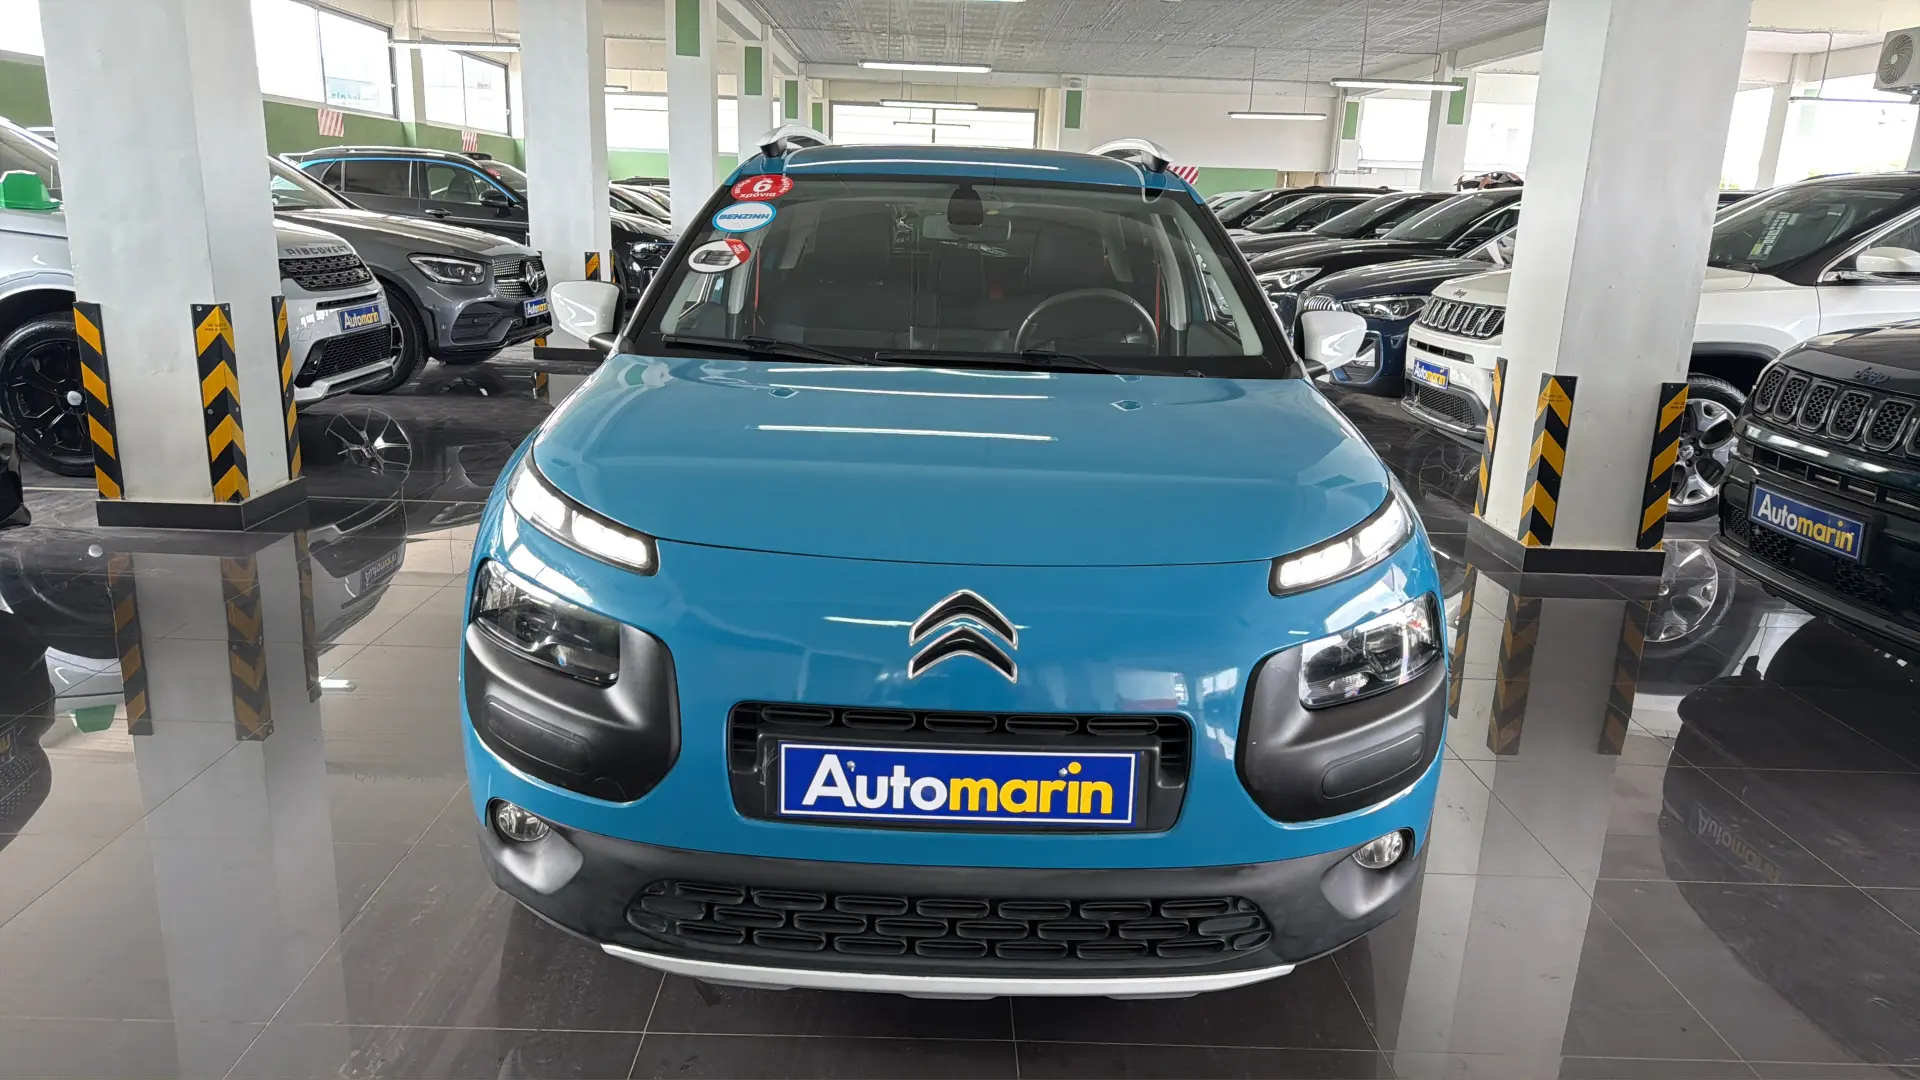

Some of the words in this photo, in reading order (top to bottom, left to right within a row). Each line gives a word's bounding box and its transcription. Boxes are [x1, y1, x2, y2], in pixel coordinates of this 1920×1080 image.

[739, 191, 777, 199] χρόνια
[753, 179, 774, 193] 6
[284, 244, 349, 256] DISCOVERY
[344, 307, 380, 330] Automarin
[1413, 361, 1447, 387] Automarin
[1854, 366, 1892, 385] Jeep
[1757, 493, 1855, 552] Automarin
[801, 753, 1114, 815] Automarin
